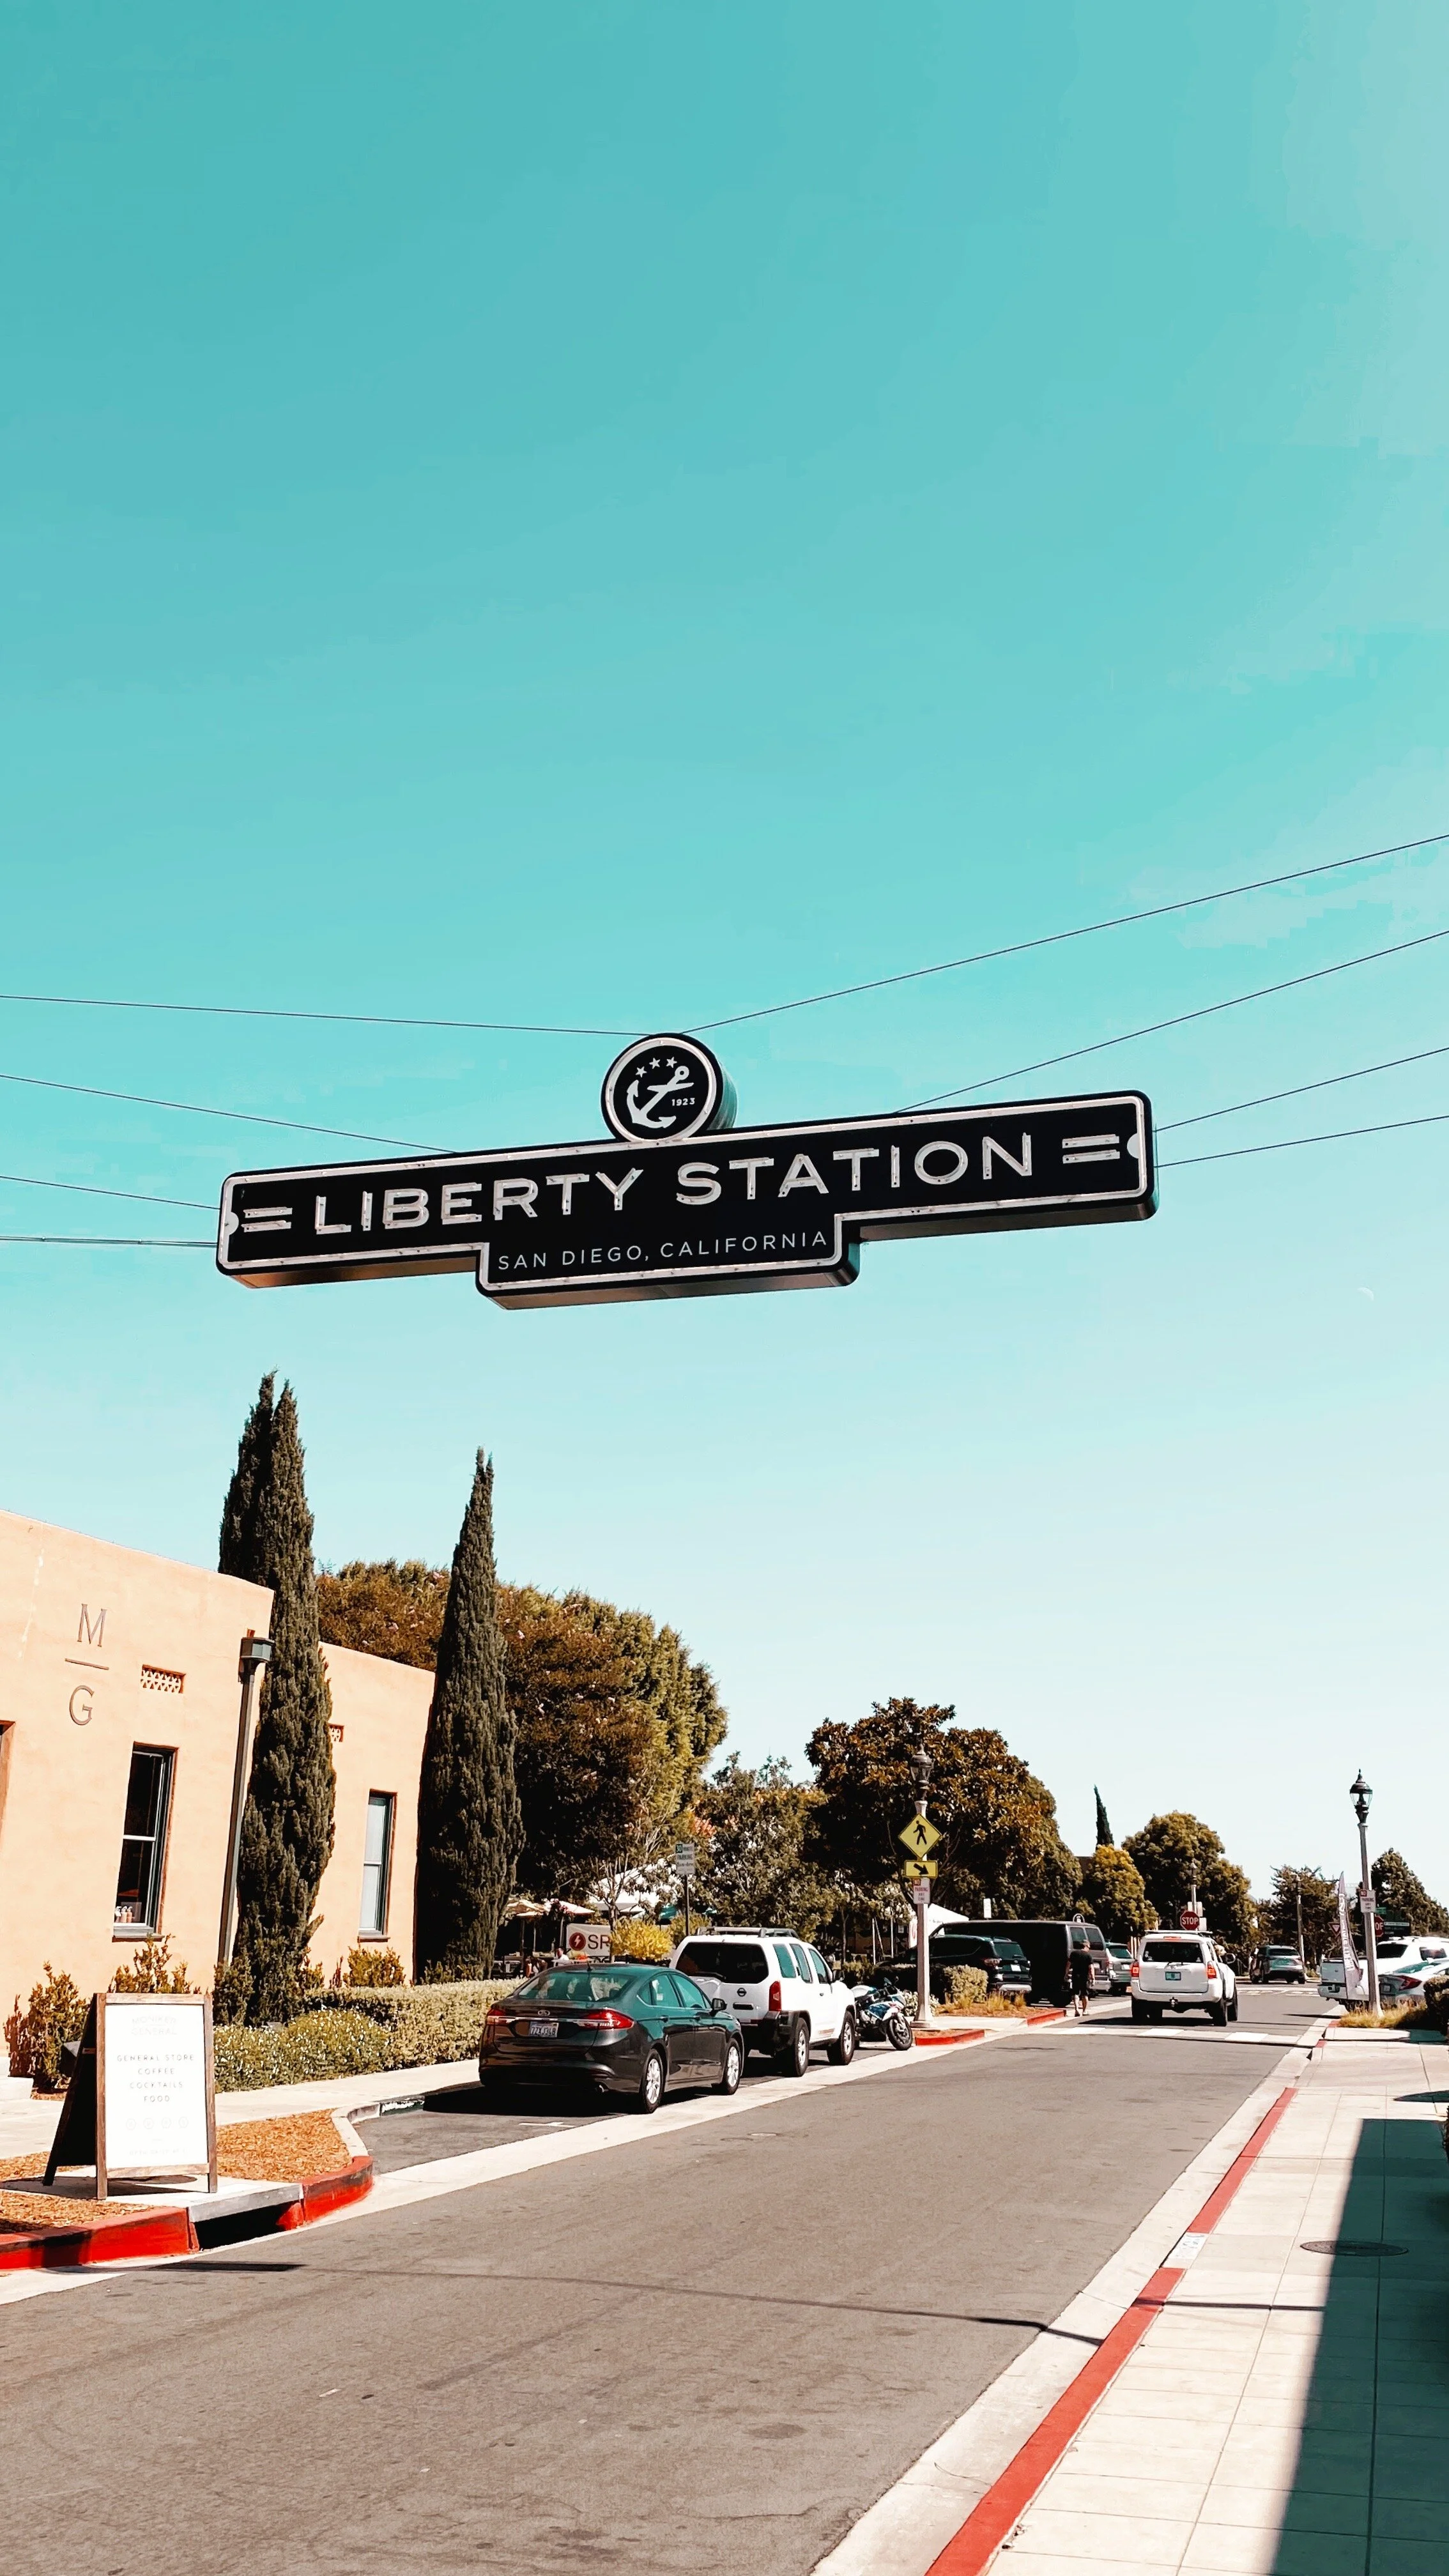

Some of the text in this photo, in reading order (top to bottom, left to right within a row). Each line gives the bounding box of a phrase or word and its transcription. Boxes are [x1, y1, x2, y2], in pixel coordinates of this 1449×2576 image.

[671, 1097, 695, 1107] 1923
[315, 1133, 1032, 1235] LIBERTY STATION
[498, 1232, 827, 1270] SAN DIEGO, CALIFORNIA
[77, 1603, 107, 1648] M
[69, 1685, 95, 1726] G
[1182, 1917, 1199, 1925] STOP
[130, 2081, 183, 2089] COCKTAILS
